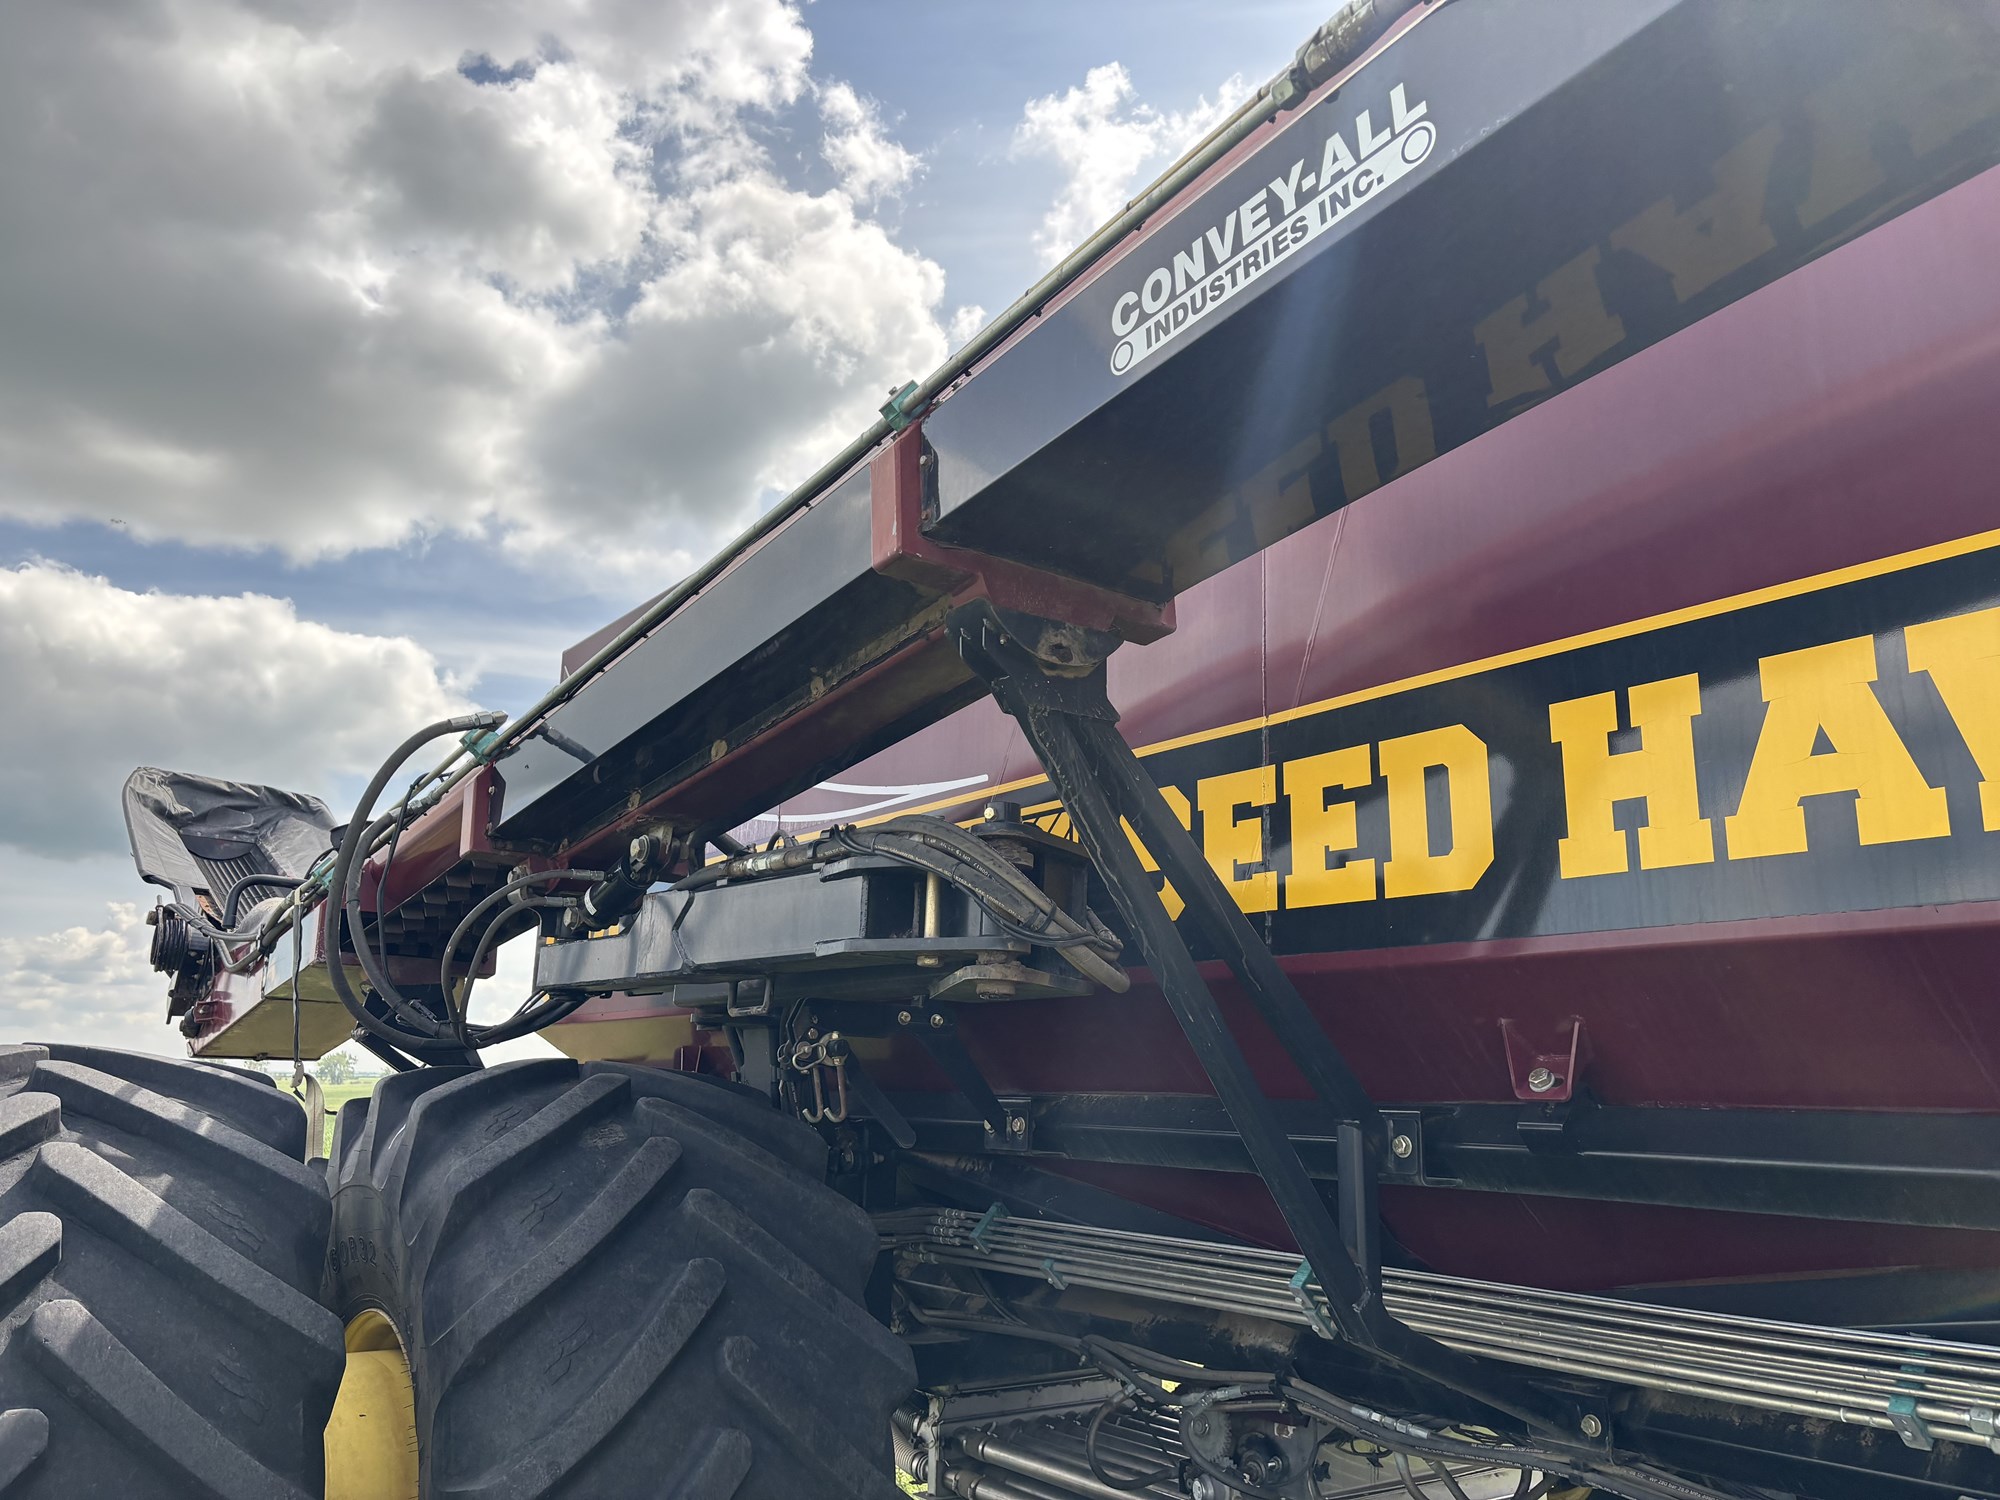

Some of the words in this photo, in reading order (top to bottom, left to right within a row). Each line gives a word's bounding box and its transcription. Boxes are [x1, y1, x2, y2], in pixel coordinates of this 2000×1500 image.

[1112, 82, 1428, 337] CONVEY-ALL
[1145, 215, 1309, 350] INDUSTRIES
[1318, 168, 1385, 226] INC.
